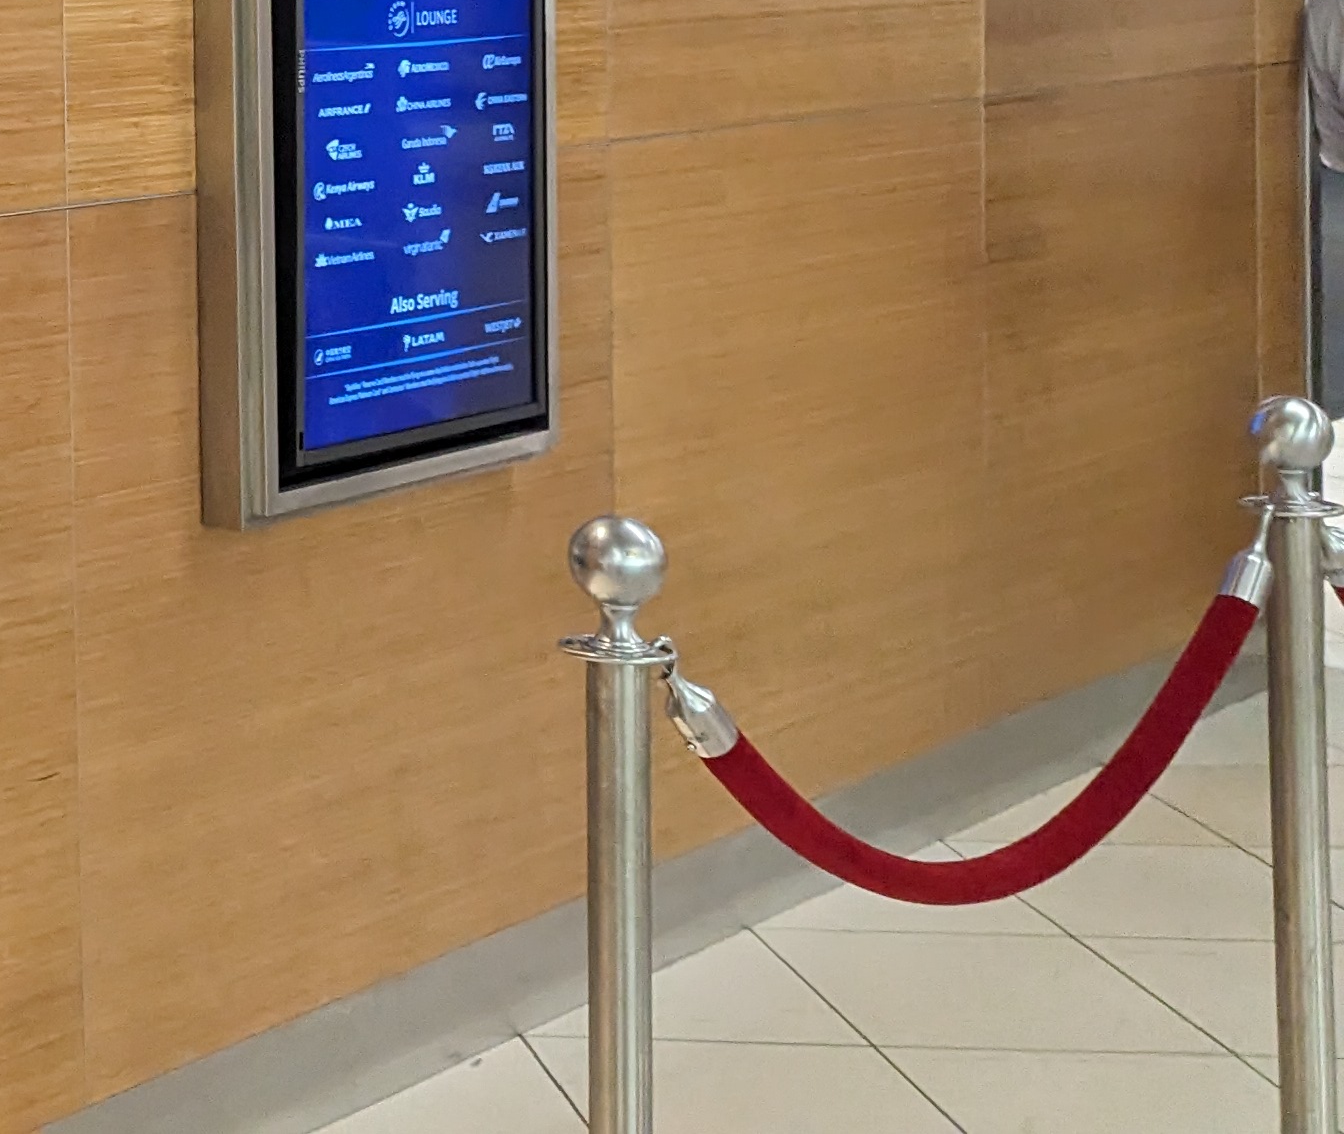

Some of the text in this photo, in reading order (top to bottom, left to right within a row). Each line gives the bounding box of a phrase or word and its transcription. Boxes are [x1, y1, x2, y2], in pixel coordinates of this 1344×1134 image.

[416, 9, 458, 26] LOUNGE
[413, 172, 435, 185] KLM
[390, 289, 458, 314] Also Serving
[412, 331, 445, 347] LATAM
